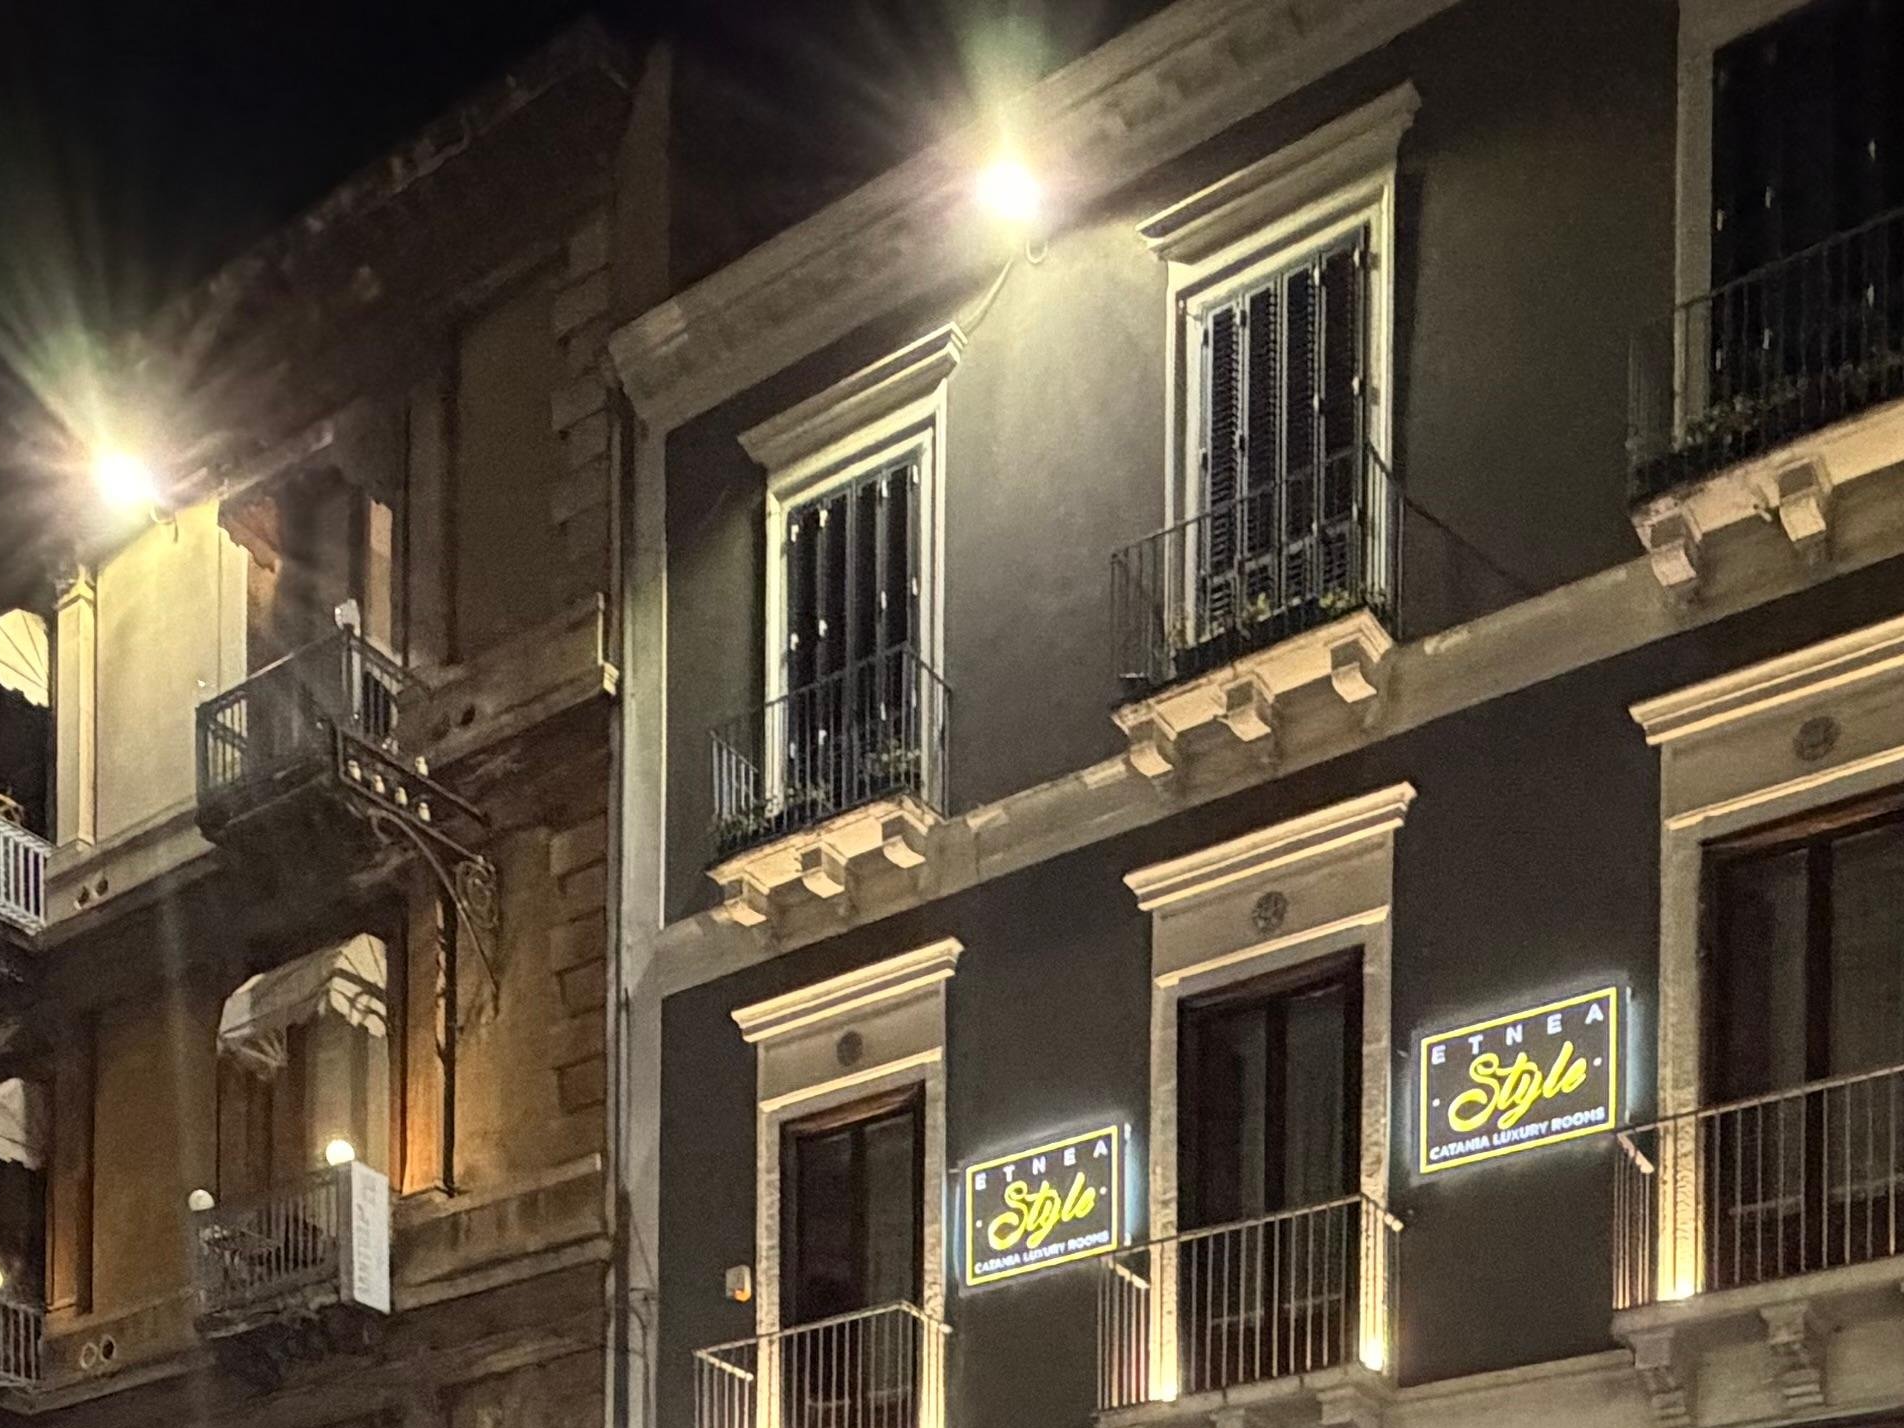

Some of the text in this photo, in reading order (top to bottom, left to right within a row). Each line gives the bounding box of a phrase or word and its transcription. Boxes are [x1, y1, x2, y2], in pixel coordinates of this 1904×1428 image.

[1431, 1003, 1604, 1065] ETNEA
[1447, 1040, 1587, 1132] Style
[1429, 1106, 1606, 1160] CATANIA LUXURY ROOMS
[975, 1140, 1108, 1190] ETNEA
[988, 1171, 1096, 1250] Style
[974, 1230, 1109, 1274] CATANIA LUXURY ROOMS
